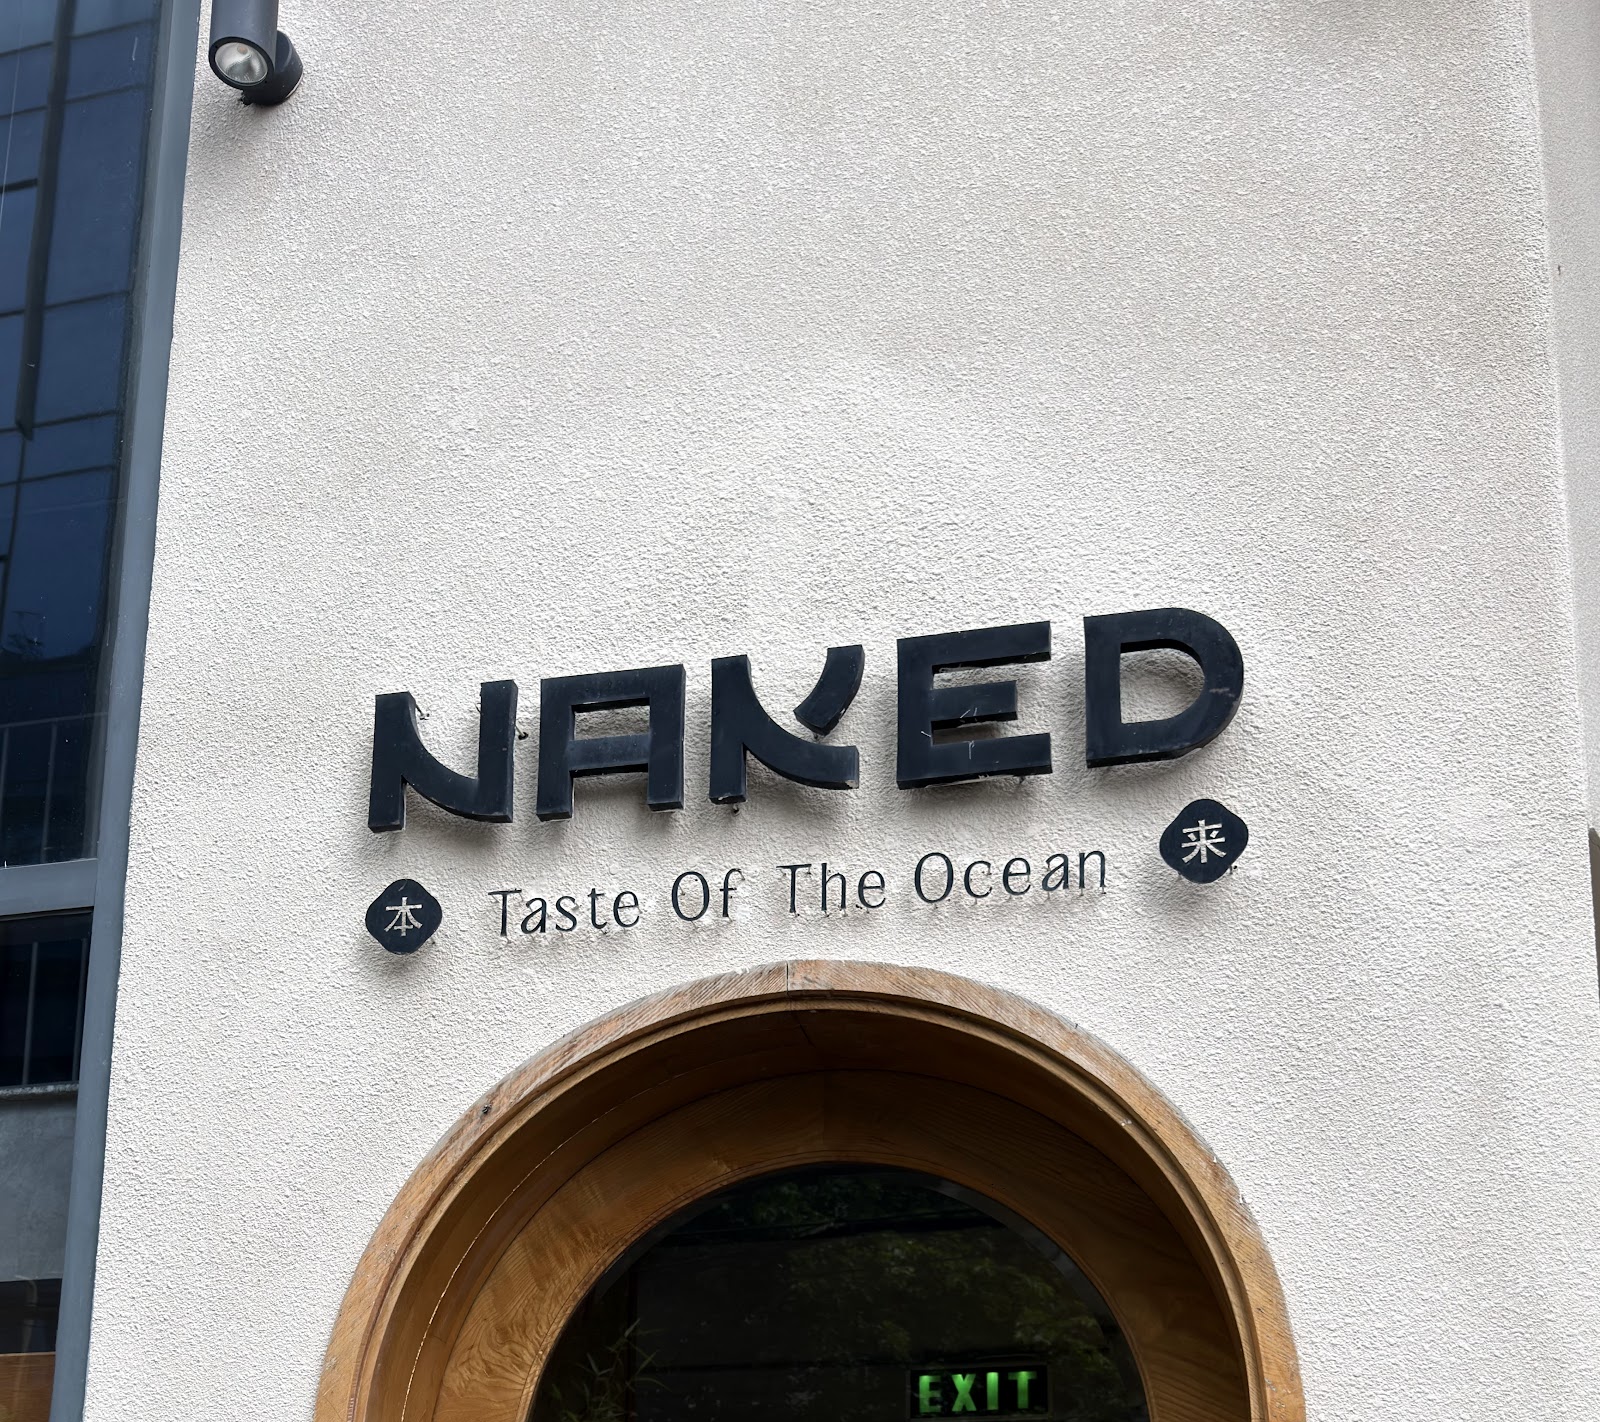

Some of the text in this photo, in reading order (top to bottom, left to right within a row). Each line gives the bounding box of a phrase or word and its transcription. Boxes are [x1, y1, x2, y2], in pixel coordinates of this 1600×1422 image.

[369, 608, 1244, 833] NAKED
[1181, 819, 1226, 865] 来
[489, 849, 1107, 937] Taste Of The Ocean
[385, 897, 424, 937] 本
[918, 1371, 1037, 1413] EXIT
